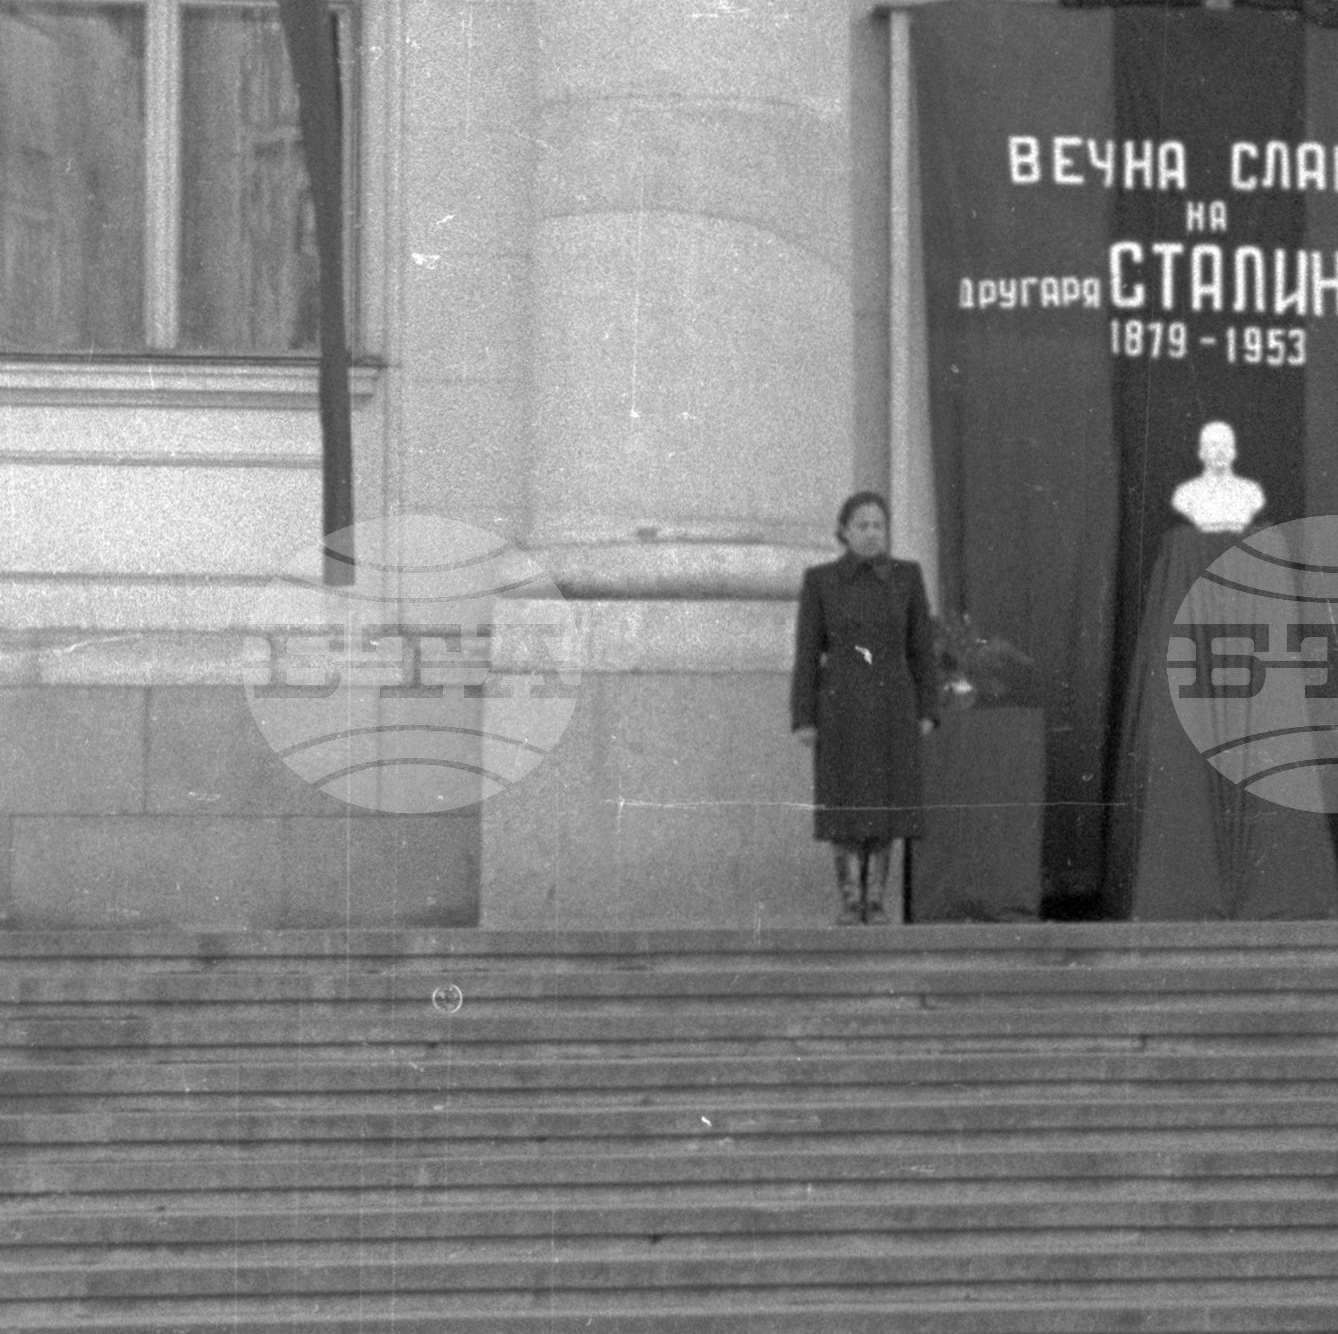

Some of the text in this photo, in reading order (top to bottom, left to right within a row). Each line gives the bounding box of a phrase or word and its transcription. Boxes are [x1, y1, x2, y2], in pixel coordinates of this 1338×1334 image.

[1009, 136, 1186, 189] ВЕЧНА
[1186, 201, 1226, 232] НА
[959, 276, 1100, 309] ДРУГАРЯ
